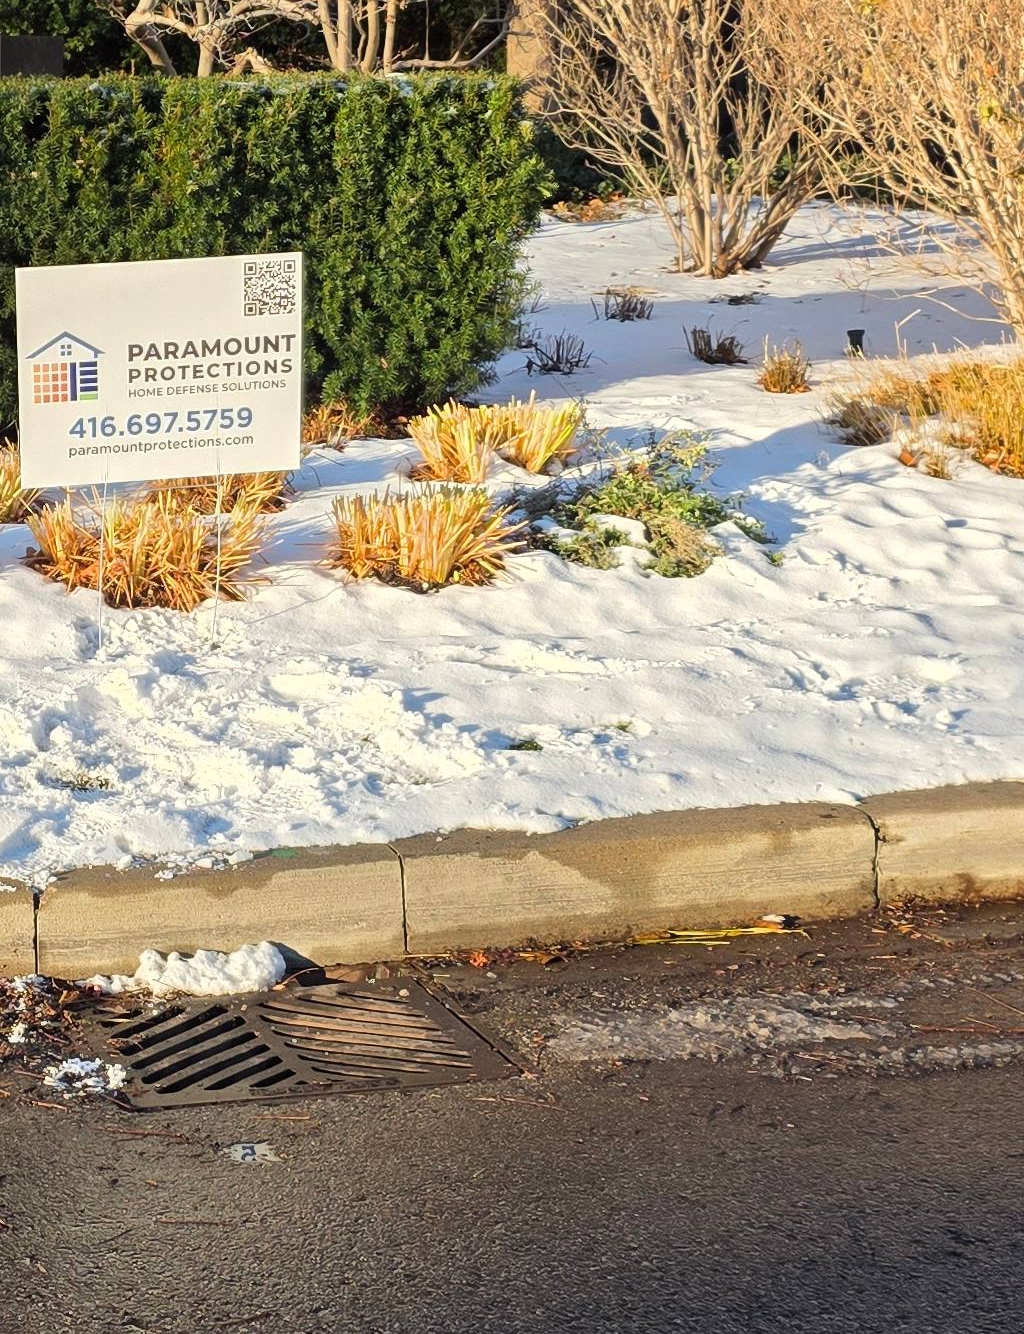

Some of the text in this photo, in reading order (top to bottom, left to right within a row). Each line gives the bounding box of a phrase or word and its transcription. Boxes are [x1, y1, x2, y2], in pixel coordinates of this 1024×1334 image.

[128, 334, 296, 362] PARAMOUNT
[128, 358, 293, 383] PROTECTIONS
[128, 379, 287, 398] HOME DEFENSE SOLUTIONS
[69, 407, 253, 438] 416.697.5759
[69, 434, 254, 458] paramountprotections.com
